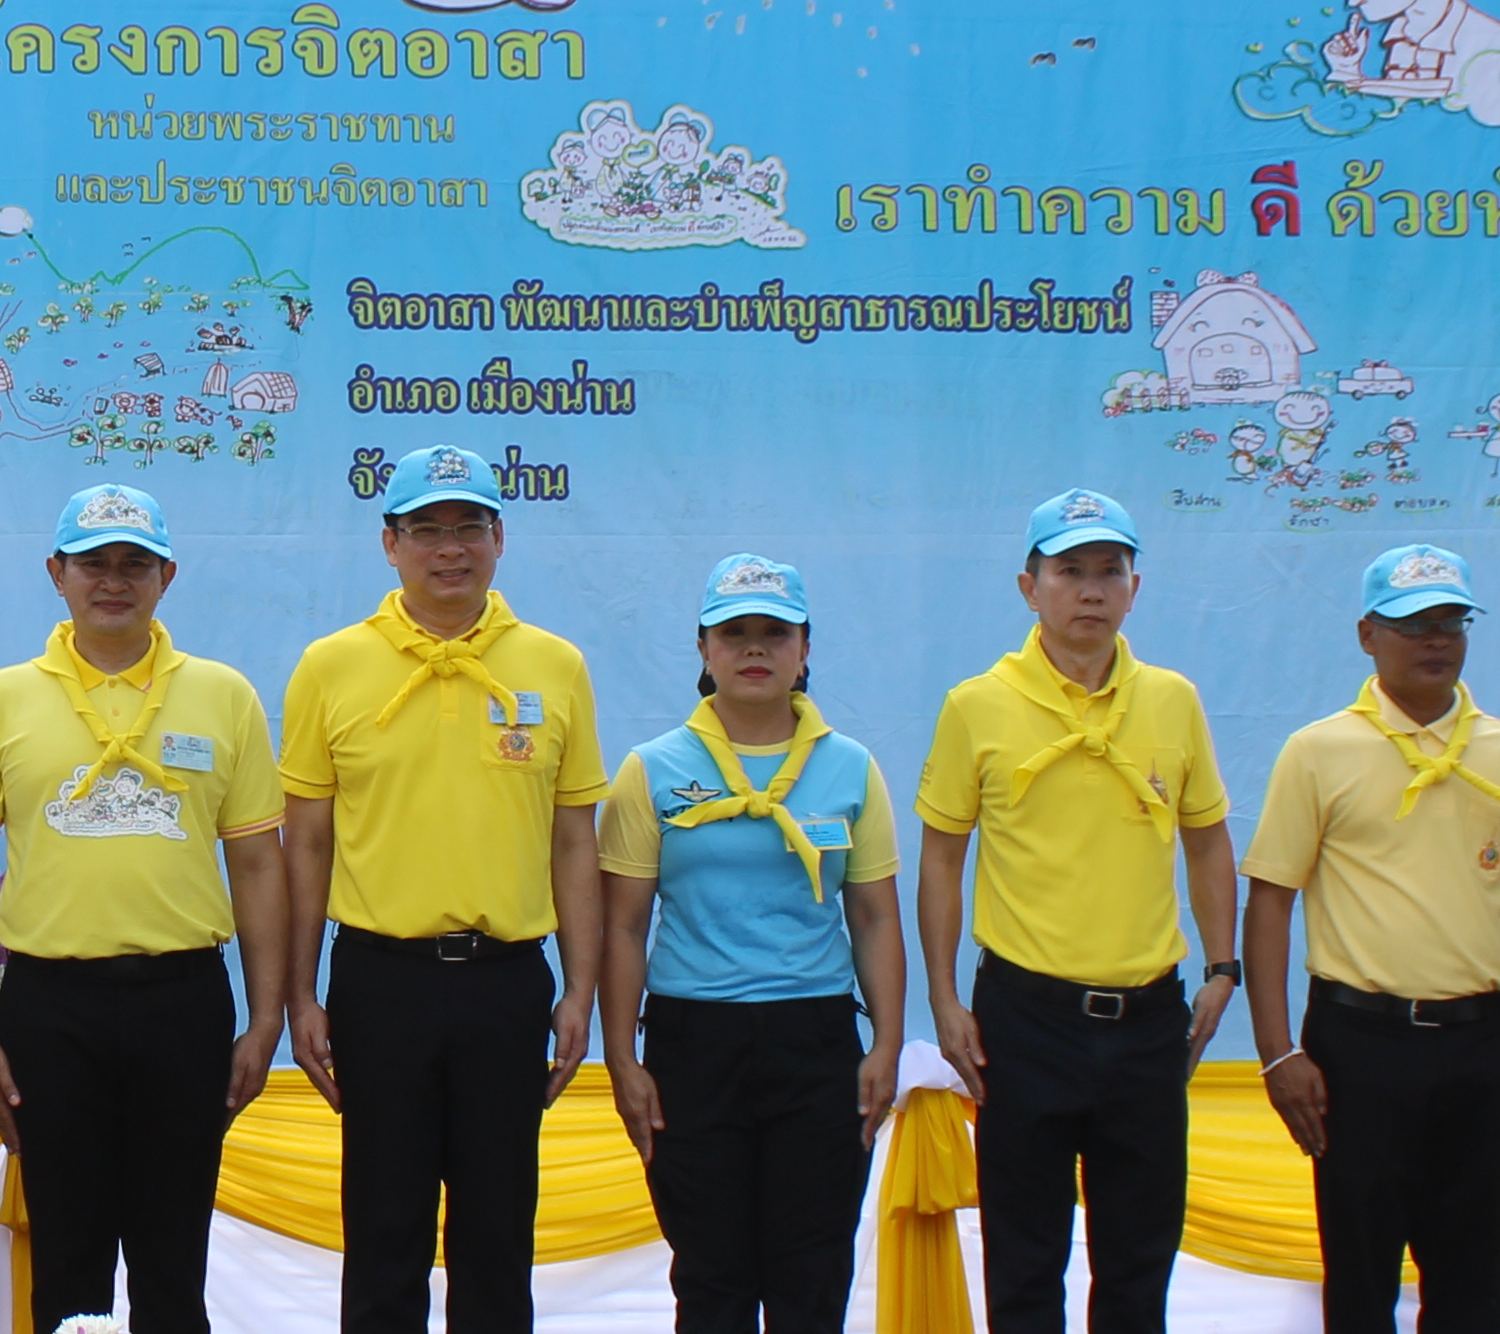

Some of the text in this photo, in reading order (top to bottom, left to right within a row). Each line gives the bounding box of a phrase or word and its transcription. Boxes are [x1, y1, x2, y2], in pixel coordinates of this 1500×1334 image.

[87, 93, 456, 144] หน่วยพระราชทาน
[54, 160, 489, 208] และประชาชนจิตอาสา
[834, 163, 1226, 237] เราทำความ
[1250, 161, 1301, 237] ดี
[346, 275, 1133, 344] จิตอาสา พัฒนาและบำเพ็ญสาธารณประโยชน์
[347, 357, 636, 416] อำเภอ เมืองน่าน
